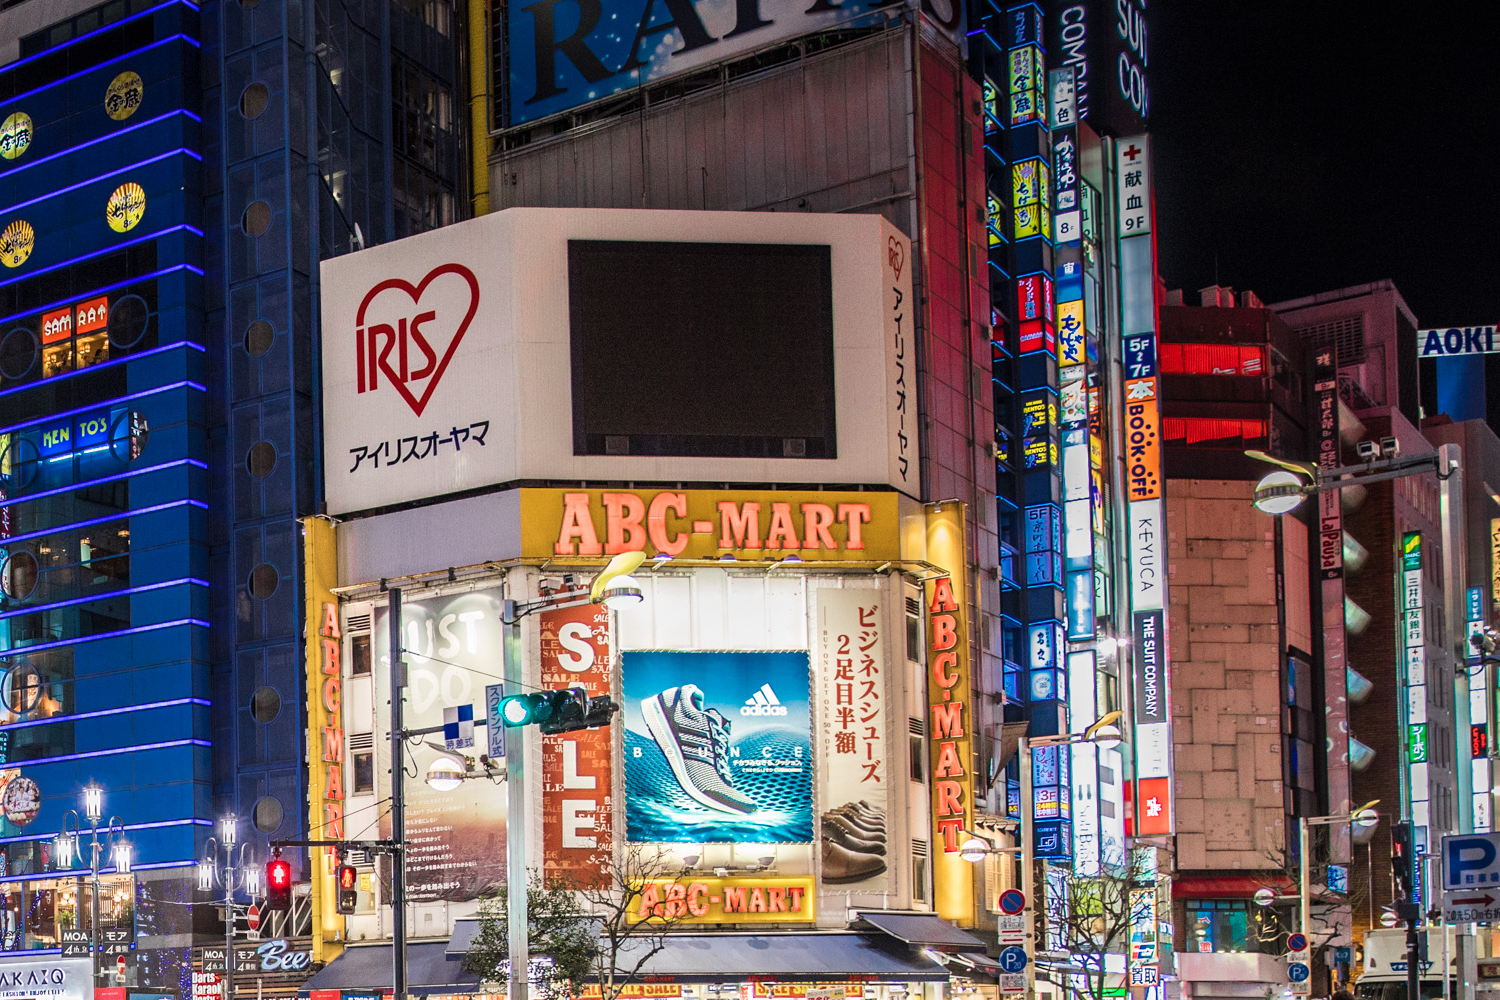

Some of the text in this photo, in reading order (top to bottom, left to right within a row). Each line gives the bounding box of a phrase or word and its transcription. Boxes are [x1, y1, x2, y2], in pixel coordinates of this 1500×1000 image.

[107, 88, 140, 112] 金の蔵
[0, 129, 31, 151] 金の蔵
[1124, 170, 1143, 211] 献血
[1125, 216, 1145, 231] 9F
[355, 308, 439, 394] IRIS
[1129, 338, 1150, 352] 5F
[1422, 326, 1494, 356] AOKI
[890, 286, 910, 484] アイリスオーヤマ
[1129, 365, 1151, 378] 7F
[349, 420, 491, 473] アイリスオーヤマ
[555, 492, 871, 557] ABC-MART
[1029, 509, 1047, 520] 5F
[1138, 518, 1155, 592] KEYUCA
[1322, 516, 1340, 569] LaPausa
[1407, 577, 1420, 639] 三井住友銀行
[1143, 616, 1157, 717] THE SUIT COMPANY
[834, 634, 857, 755] 2足目半額
[857, 604, 881, 783] ビジネスシューズ
[489, 687, 502, 756] スクランブル式
[740, 704, 788, 716] adidas
[930, 577, 964, 854] ABC-MART
[558, 622, 597, 848] SLE
[1472, 728, 1480, 756] union
[581, 751, 596, 759] SALE
[1151, 728, 1161, 773] WHITE
[1040, 789, 1057, 801] 3F
[1449, 838, 1497, 885] P
[639, 882, 806, 918] ABC-MART
[63, 932, 88, 940] MOA
[105, 931, 128, 941] モア
[204, 951, 224, 959] MOA
[238, 951, 255, 959] モア
[257, 939, 310, 970] Bee
[1006, 953, 1018, 970] P
[192, 972, 216, 984] Darts
[1131, 967, 1158, 985] 買取
